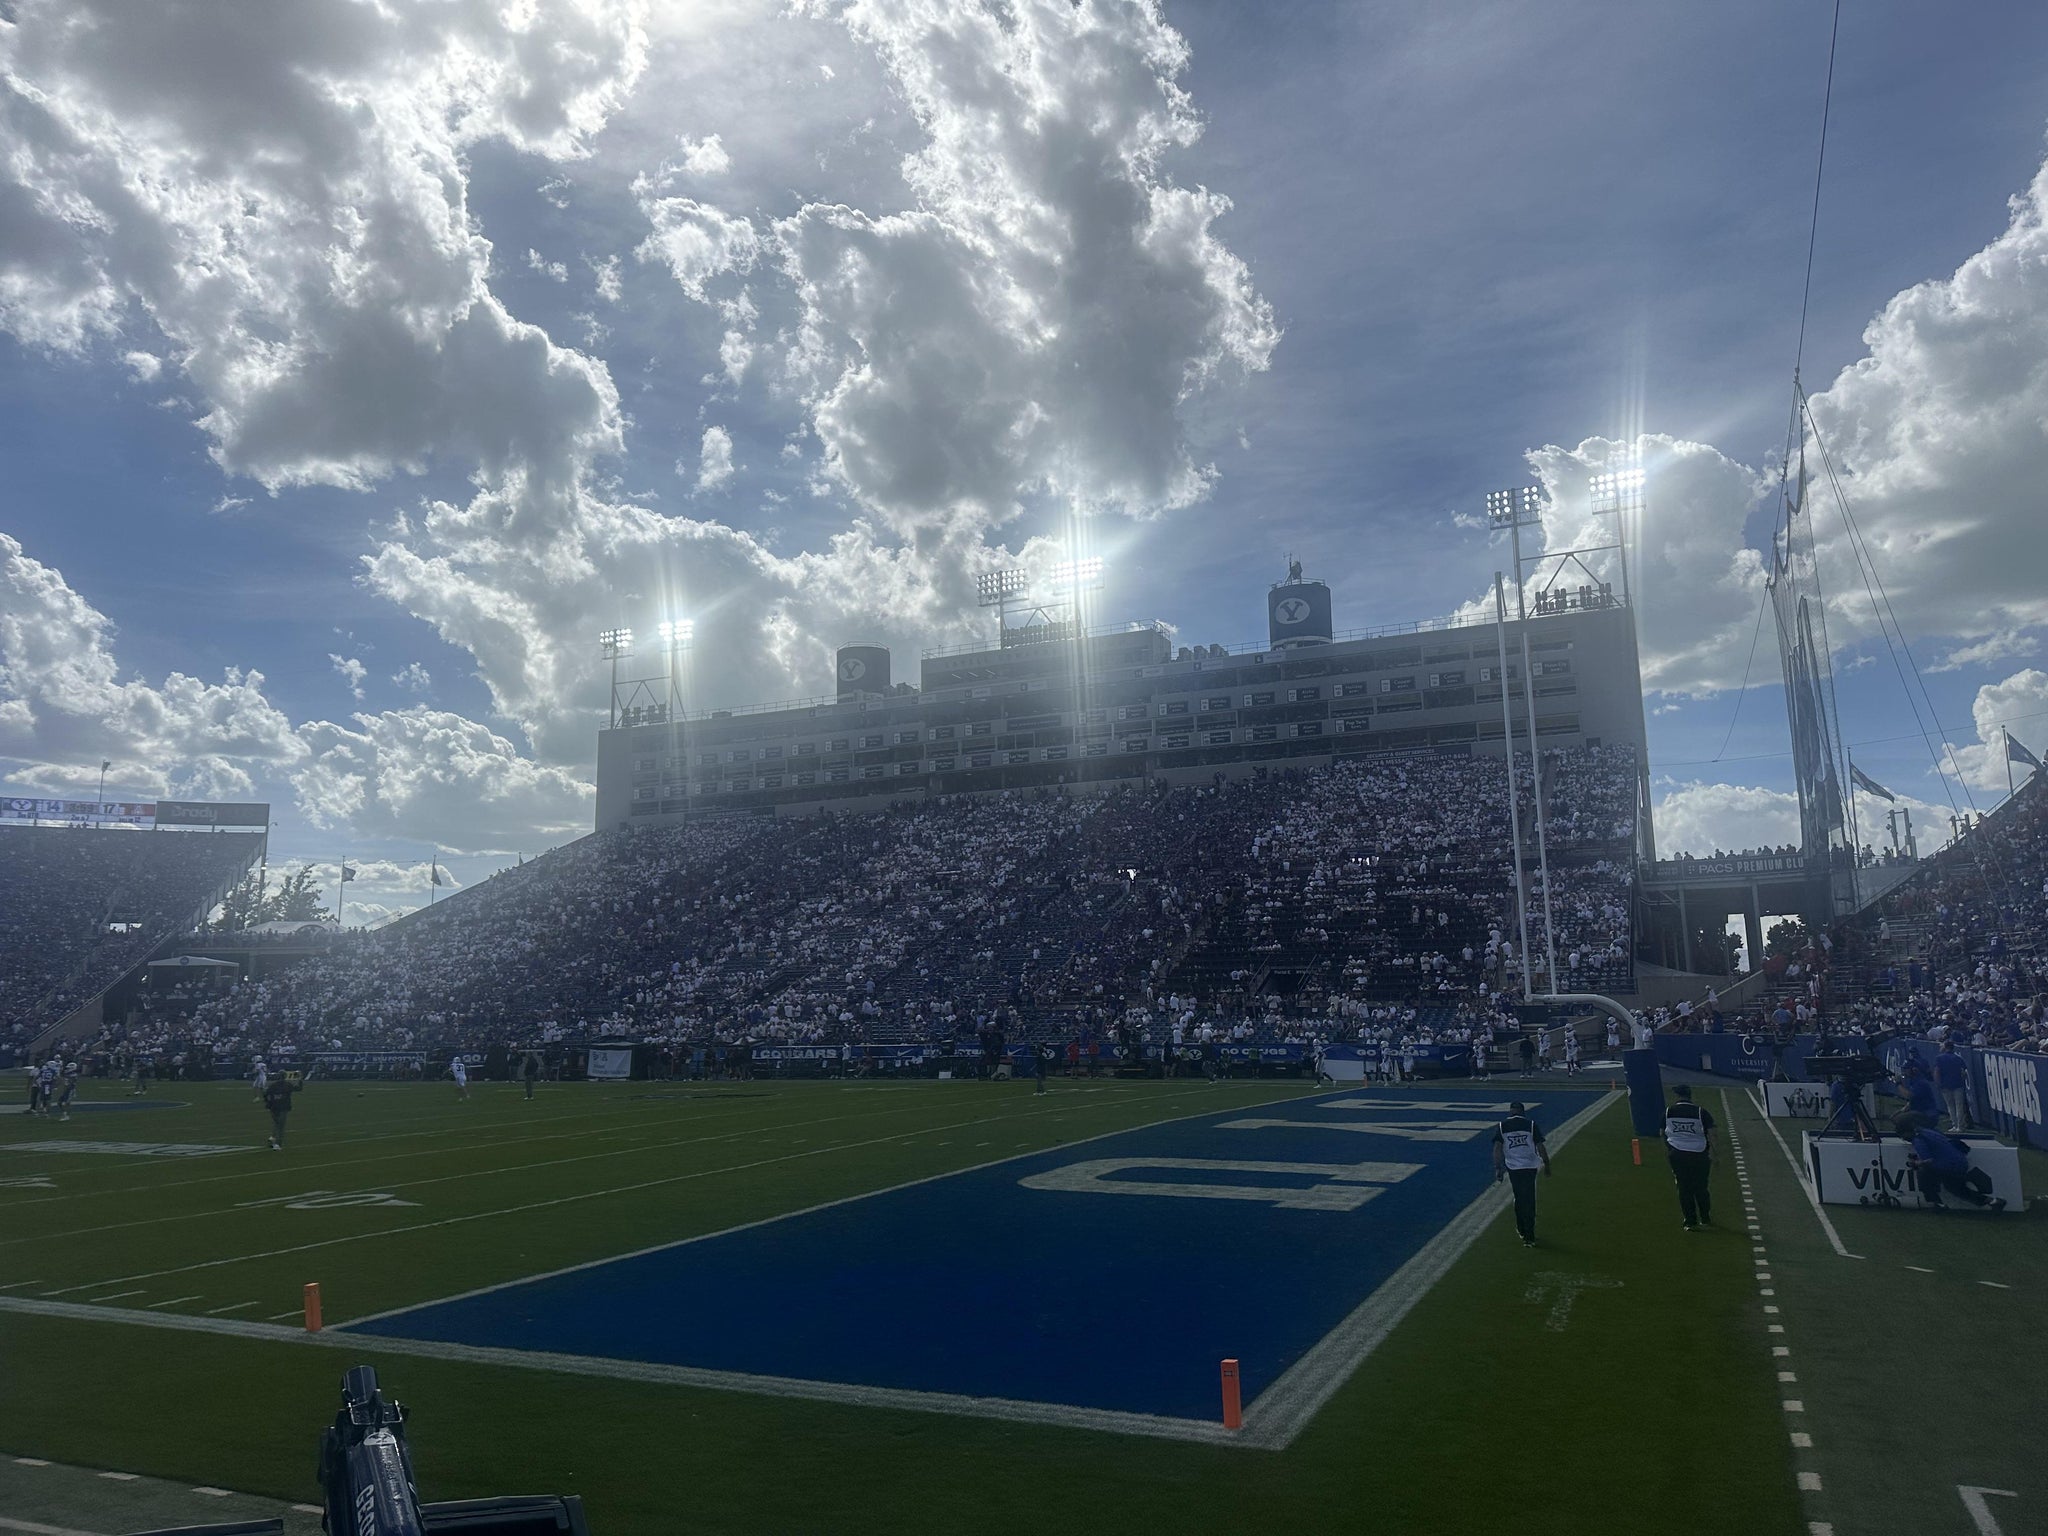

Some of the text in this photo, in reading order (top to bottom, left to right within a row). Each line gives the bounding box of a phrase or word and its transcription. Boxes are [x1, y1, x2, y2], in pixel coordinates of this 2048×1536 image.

[1279, 600, 1305, 622] Y
[103, 804, 116, 814] 17
[1699, 856, 1804, 874] PACS PREMIUM CLU
[760, 1049, 838, 1059] COUGARS
[1241, 1048, 1287, 1056] CUGS
[1357, 1049, 1376, 1057] GO
[1984, 1053, 2042, 1125] GO COUGS
[1783, 1092, 1831, 1111] vivin
[1847, 1159, 1916, 1192] vivi
